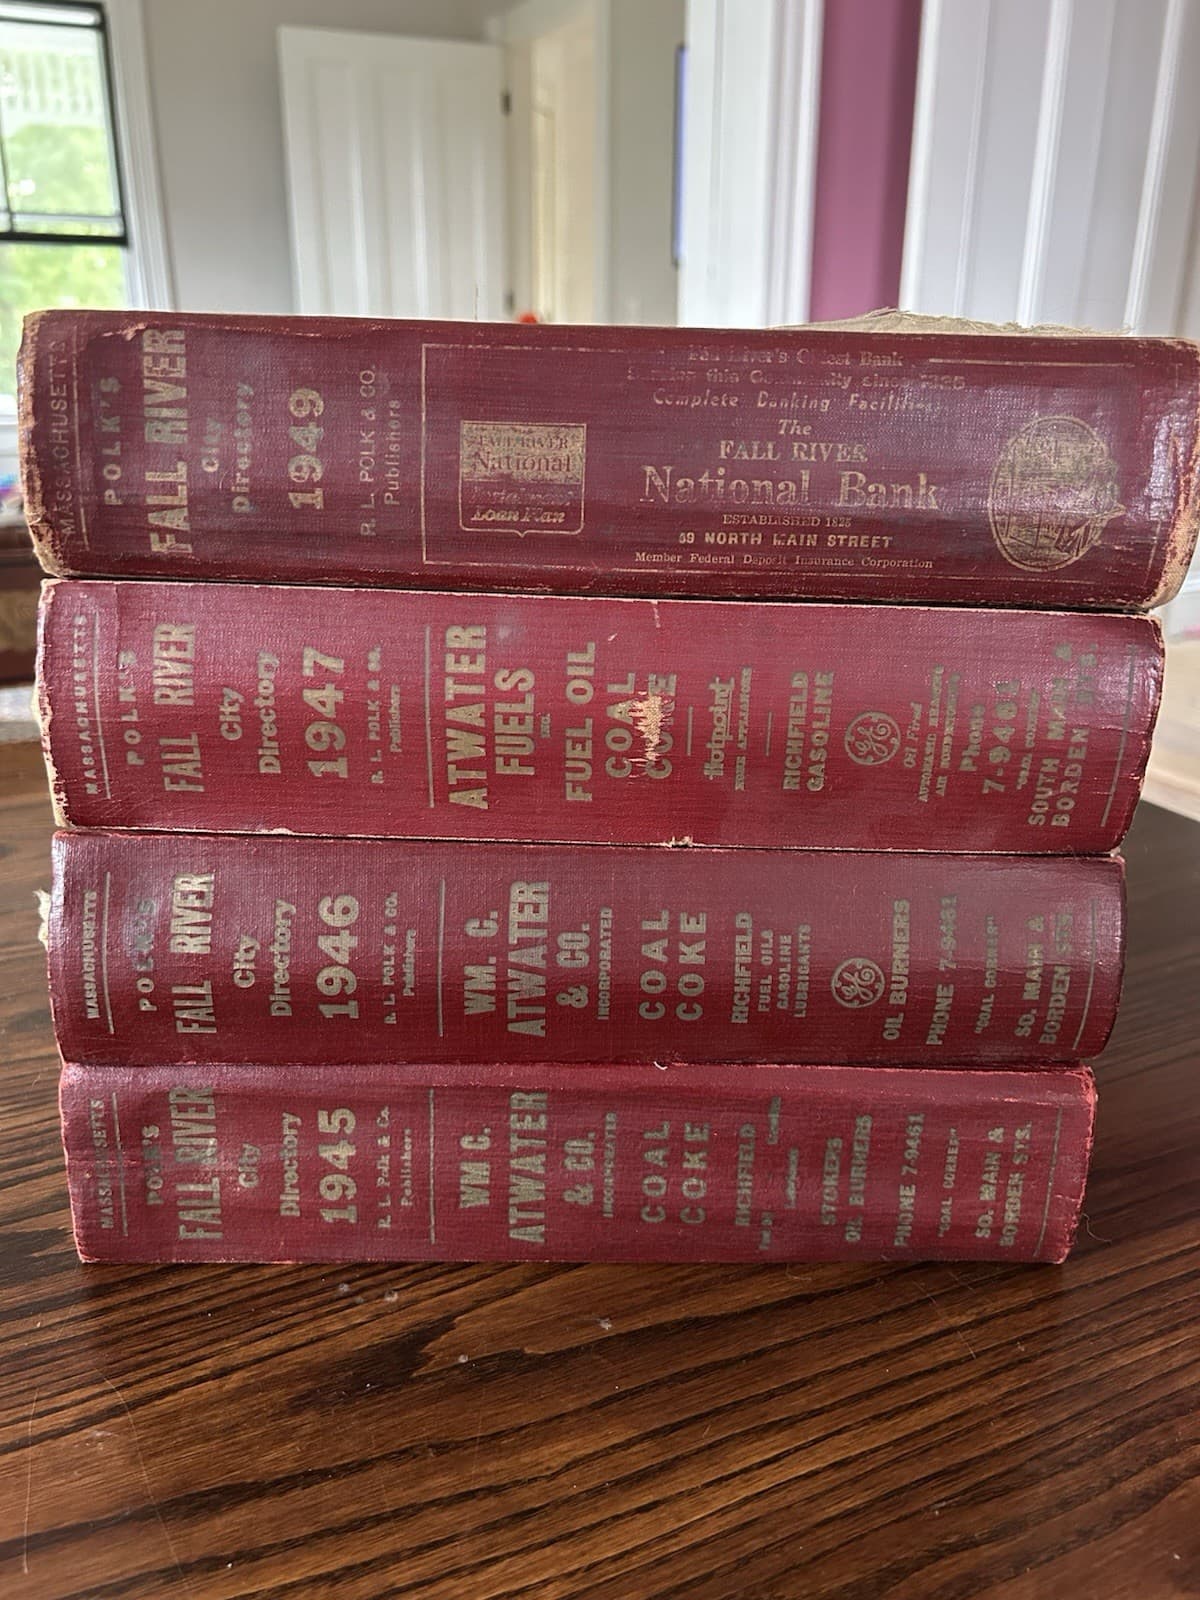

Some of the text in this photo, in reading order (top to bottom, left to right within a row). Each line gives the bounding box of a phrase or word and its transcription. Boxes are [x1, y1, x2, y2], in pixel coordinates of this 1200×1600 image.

[859, 351, 904, 366] Bank
[48, 340, 75, 534] MASSACHUSETTS
[99, 377, 123, 505] POLK'S
[143, 329, 192, 553] FALL RIVER
[200, 417, 221, 472] City
[231, 381, 255, 513] Directory
[287, 387, 325, 510] 1949
[359, 365, 376, 536] R. L. POLK & CO.
[385, 399, 401, 505] Publishers
[472, 451, 572, 472] National
[718, 440, 869, 462] FALL RIVER
[778, 419, 812, 435] The
[639, 465, 939, 510] National Bank
[704, 532, 763, 545] NORTH
[827, 535, 893, 548] STREET
[722, 514, 821, 527] ESTABLISHED
[634, 552, 682, 563] Member
[689, 553, 735, 564] Federal
[795, 555, 855, 567] Insurance
[861, 556, 933, 569] Corporation
[73, 614, 98, 794] MASSACHUSETTS
[153, 623, 205, 792] FALL RIVER
[219, 687, 245, 740] City
[254, 652, 281, 774] Directory
[302, 646, 348, 778] 1947
[369, 680, 380, 690] &
[369, 700, 380, 740] POLK
[445, 625, 488, 810] ATWATER
[494, 667, 536, 776] FUELS
[565, 641, 596, 802] FUEL OIL
[605, 672, 635, 778] COAL
[703, 677, 734, 780] Hotpoint
[783, 671, 809, 790] RICHFIELD
[807, 671, 834, 791] GASOLINE
[960, 704, 985, 771] Phone
[904, 746, 918, 768] Oil
[1029, 758, 1060, 825] SOUTH
[1048, 678, 1072, 740] MAIN
[1052, 728, 1089, 827] BORDEN
[82, 891, 100, 1018] MASSACHUSETTS
[169, 872, 217, 1033] FALL RIVER
[233, 935, 260, 988] City
[269, 898, 296, 1016] Directory
[316, 894, 360, 1019] 1946
[383, 892, 398, 1024] R. L. POLK & CO.
[464, 911, 498, 1014] WM. C.
[508, 881, 549, 1037] ATWATER
[556, 923, 590, 1008] & CO.
[597, 907, 613, 1020] INCORPORATED
[639, 909, 670, 1020] COAL
[676, 912, 707, 1021] COKE
[731, 912, 753, 1023] RICHFIELD
[758, 975, 773, 1011] FUEL
[778, 935, 792, 1009] GASOLINE
[794, 924, 812, 1017] LUBRICANTS
[883, 898, 910, 1040] OIL BURNERS
[1014, 916, 1044, 1037] SO. MAIN &
[1039, 965, 1070, 1044] BORDEN
[925, 984, 955, 1045] PHONE
[169, 1087, 223, 1240] FALL RIVER
[238, 1143, 262, 1188] City
[280, 1112, 301, 1217] Directory
[317, 1107, 358, 1224] 1945
[376, 1154, 390, 1187] Polk
[378, 1135, 390, 1147] &
[400, 1128, 413, 1206] Publishers
[460, 1127, 491, 1150] C.
[509, 1092, 548, 1244] ATWATER
[563, 1131, 596, 1205] & CO.
[602, 1112, 617, 1218] INCORPORATED
[640, 1121, 670, 1223] COAL
[680, 1122, 710, 1224] COKE
[735, 1124, 755, 1226] RICHFIELD
[821, 1137, 842, 1225] STOKERS
[845, 1115, 873, 1242] OIL BURNERS
[894, 1113, 925, 1247] PHONE 7-9461
[974, 1127, 1004, 1238] SO. MAIN &
[1000, 1121, 1033, 1247] BORDEN STS.
